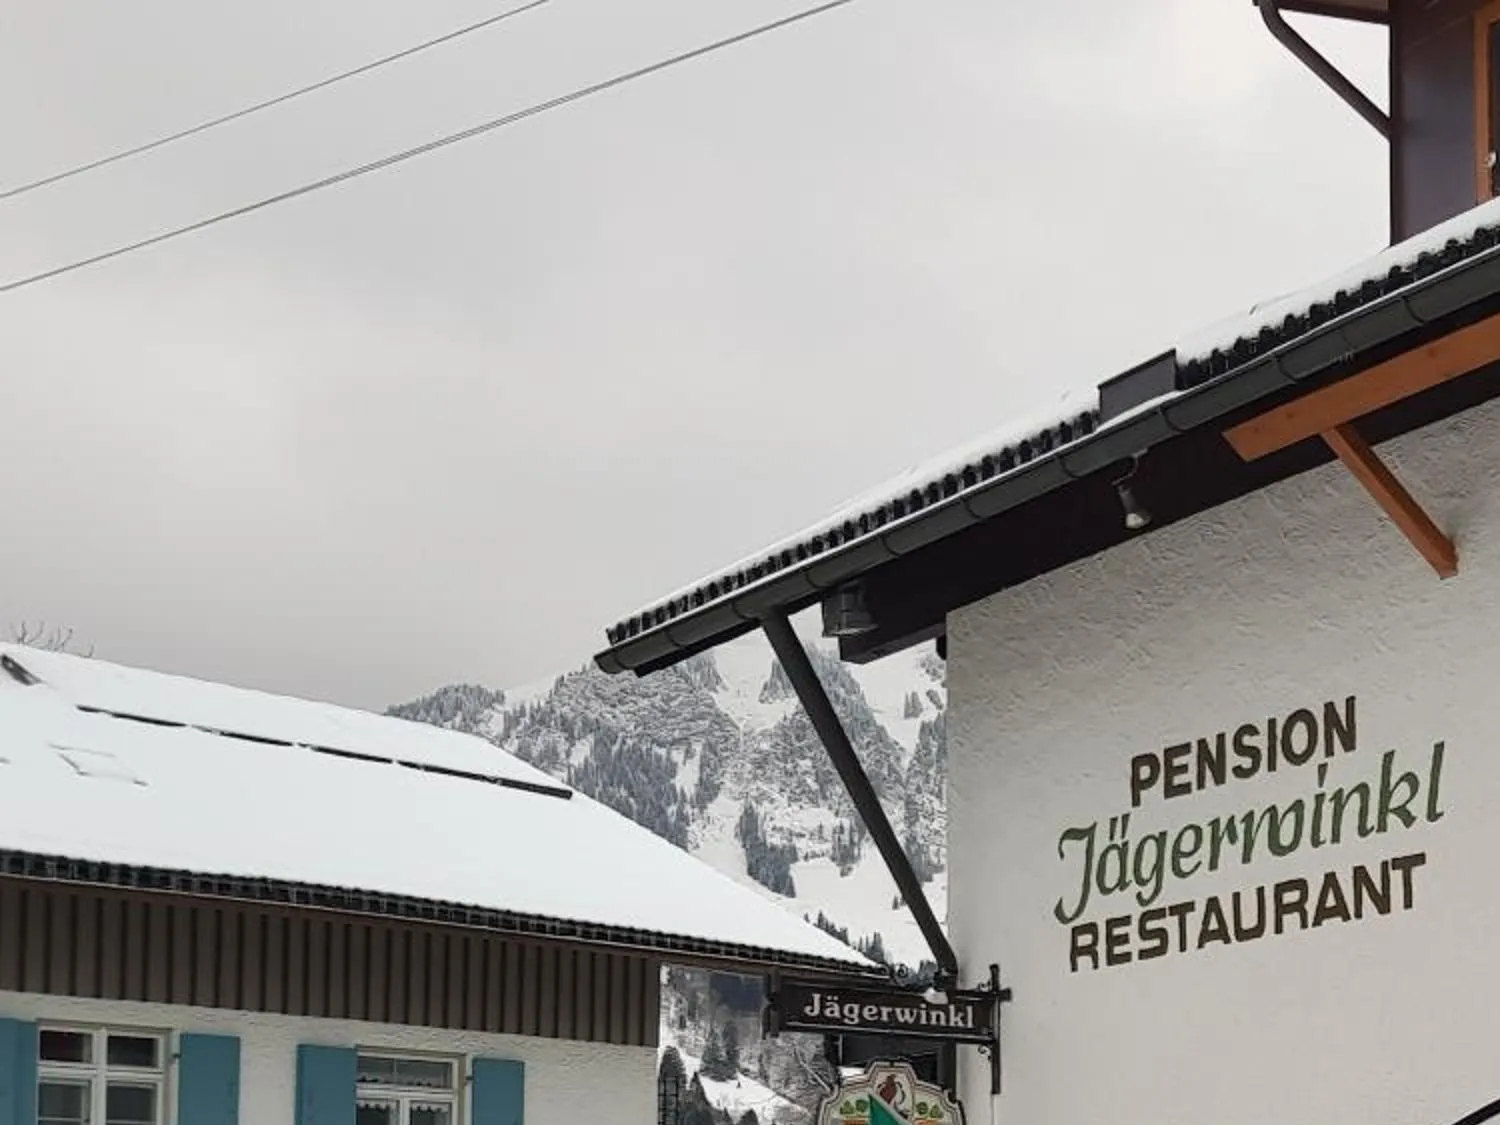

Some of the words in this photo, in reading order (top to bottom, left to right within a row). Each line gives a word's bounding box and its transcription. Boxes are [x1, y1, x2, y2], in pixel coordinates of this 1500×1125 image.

[1130, 695, 1357, 807] PENSION
[1053, 741, 1446, 925] Jägerwinkl
[1069, 852, 1426, 972] RESTAURANT
[803, 992, 975, 1029] Jägerwinkl
